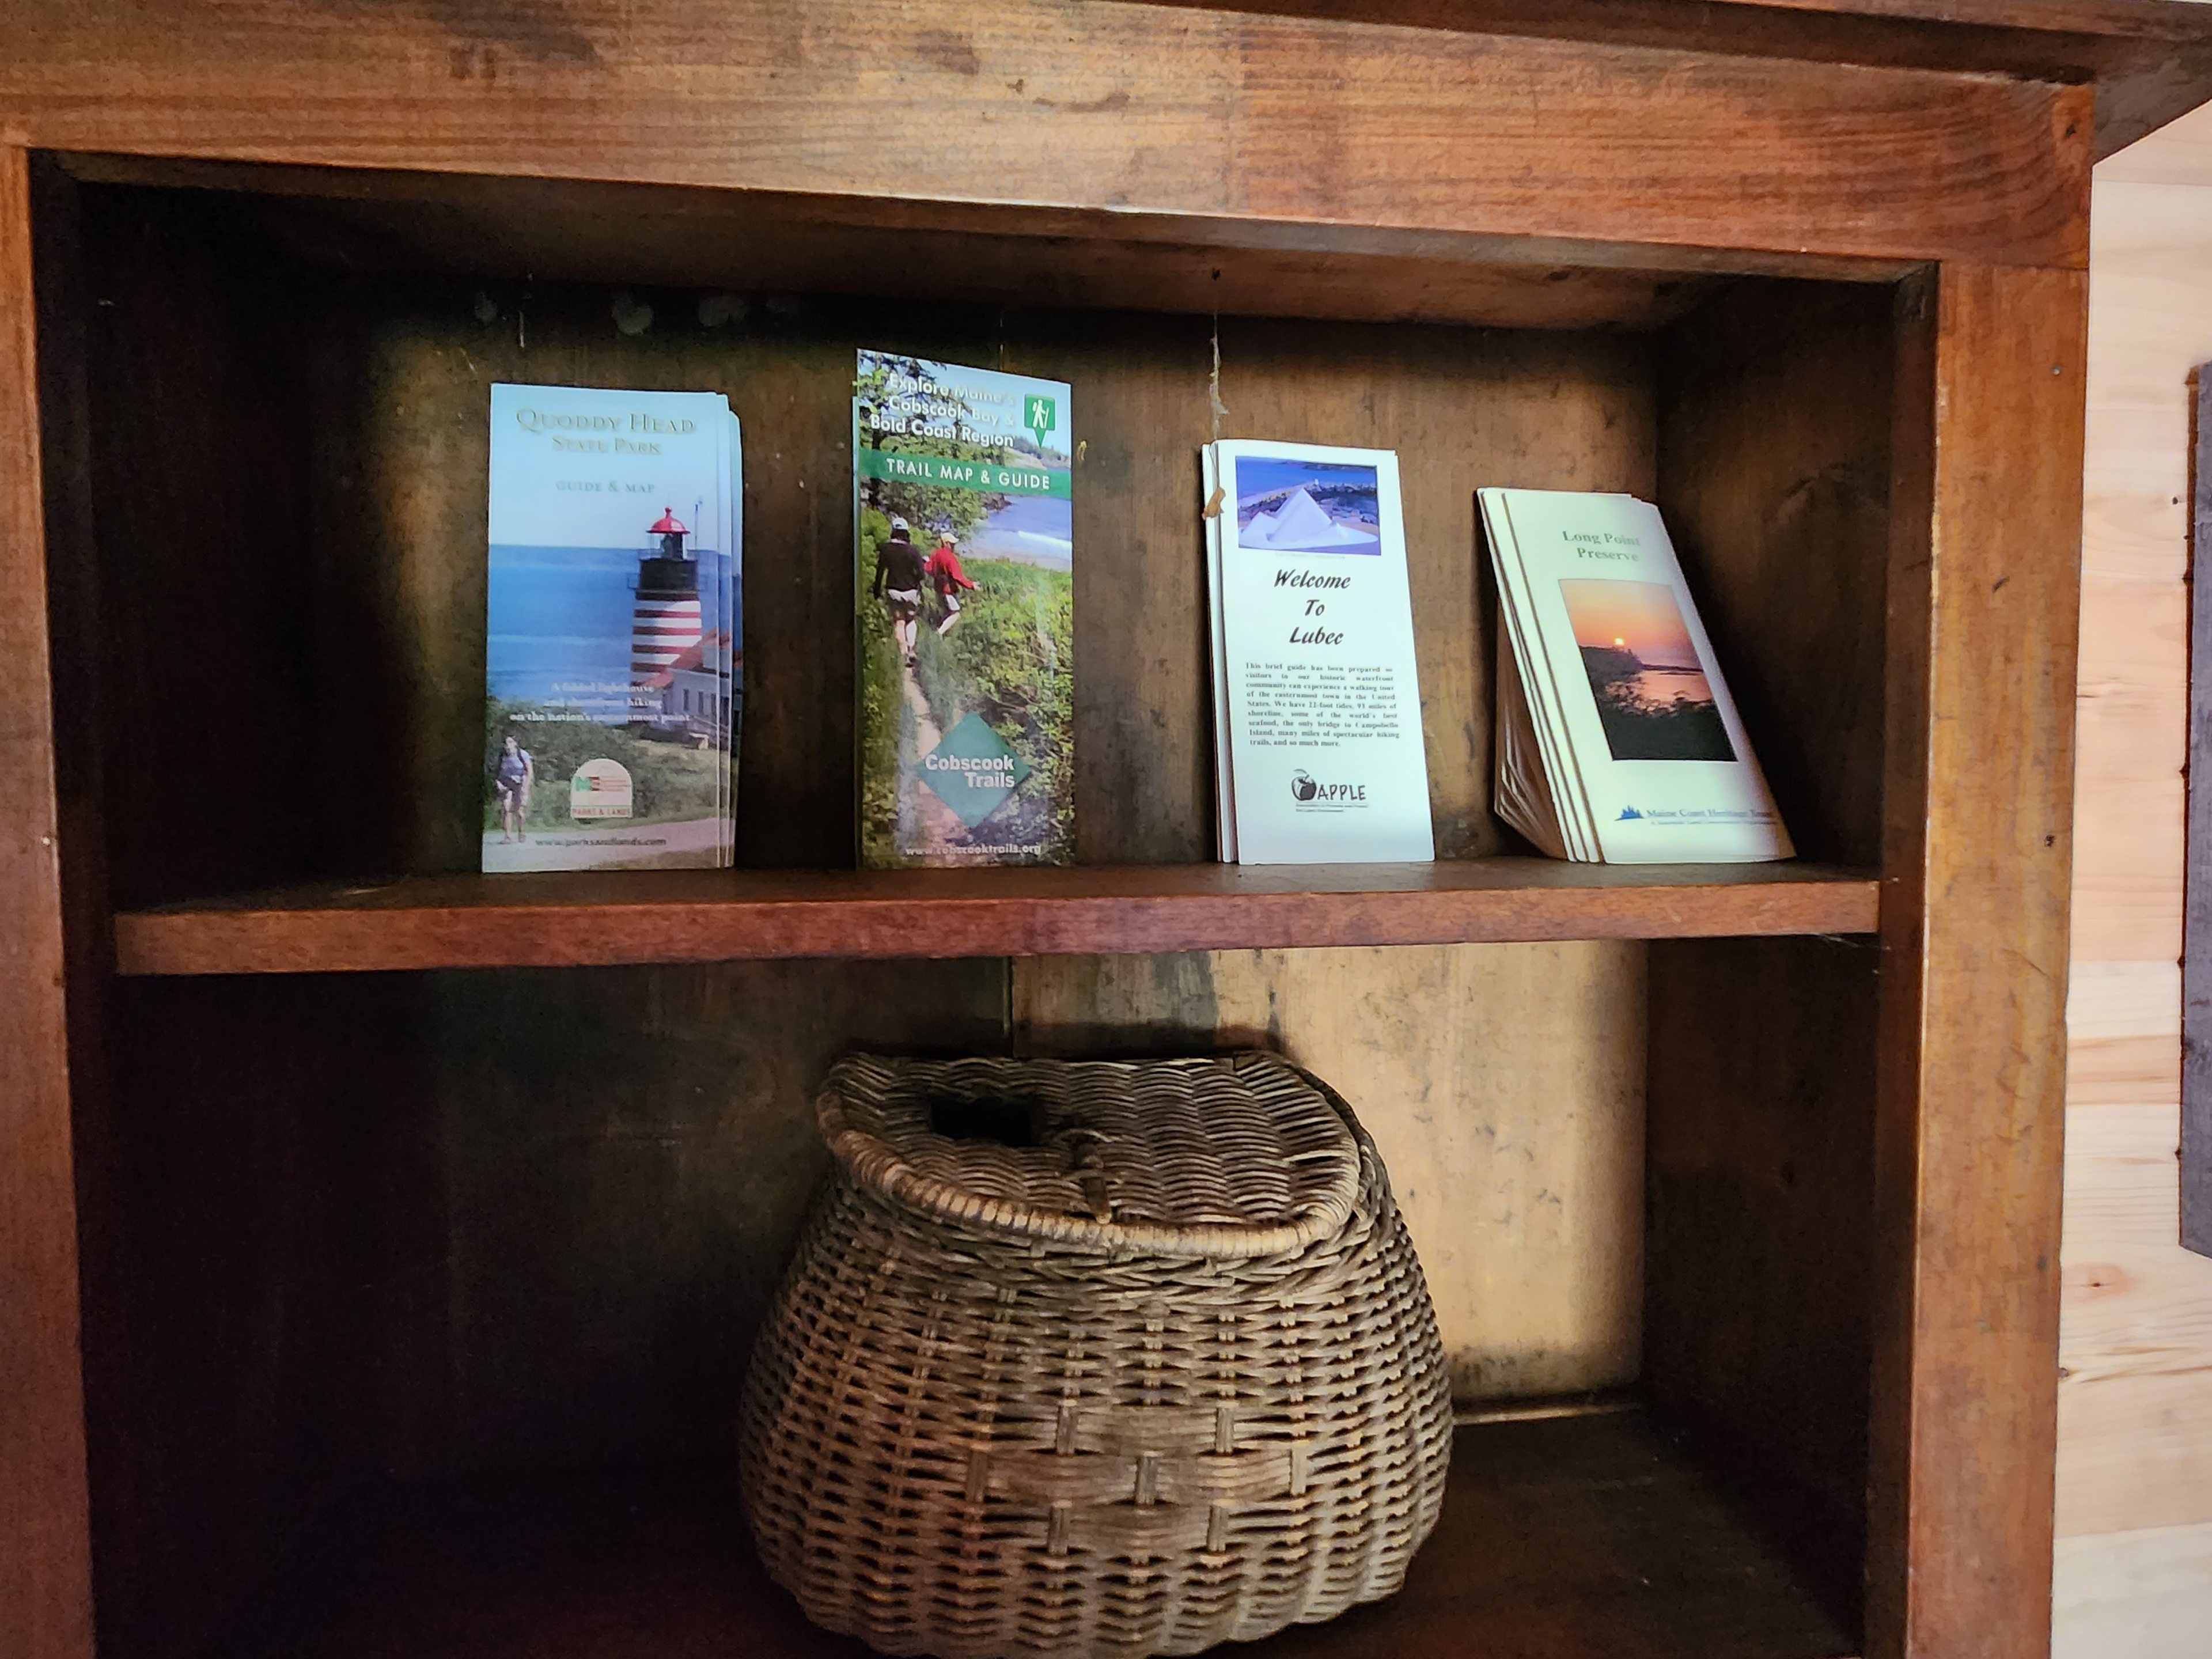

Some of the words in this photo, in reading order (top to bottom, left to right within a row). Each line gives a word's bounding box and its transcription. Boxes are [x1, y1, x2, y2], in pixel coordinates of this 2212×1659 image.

[889, 372, 949, 397] Explore
[954, 385, 1015, 406] Maine's
[888, 395, 965, 419] Cobscook
[972, 407, 999, 427] Bay
[1004, 414, 1014, 426] &
[516, 408, 620, 433] QUODDY
[630, 412, 696, 433] HEAD
[870, 413, 907, 434] Bold
[911, 420, 957, 440] Coast
[961, 427, 1014, 448] Region
[551, 434, 606, 452] STATE
[614, 437, 662, 454] PARK
[886, 458, 932, 478] TRAIL
[940, 464, 974, 481] MAP
[980, 469, 991, 485] &
[998, 474, 1051, 490] GUIDE
[556, 480, 602, 492] GUIDE
[608, 482, 618, 492] &
[625, 483, 656, 494] MAP
[1562, 530, 1600, 544] Long
[1604, 533, 1641, 547] Point
[1577, 547, 1639, 562] Preserve
[1274, 569, 1351, 589] Welcome
[1304, 599, 1325, 616] To
[1289, 626, 1344, 646] Lubec
[527, 711, 546, 721] the
[925, 754, 1014, 771] Cobscook
[964, 772, 1015, 788] Trails
[1317, 784, 1366, 801] APPLE
